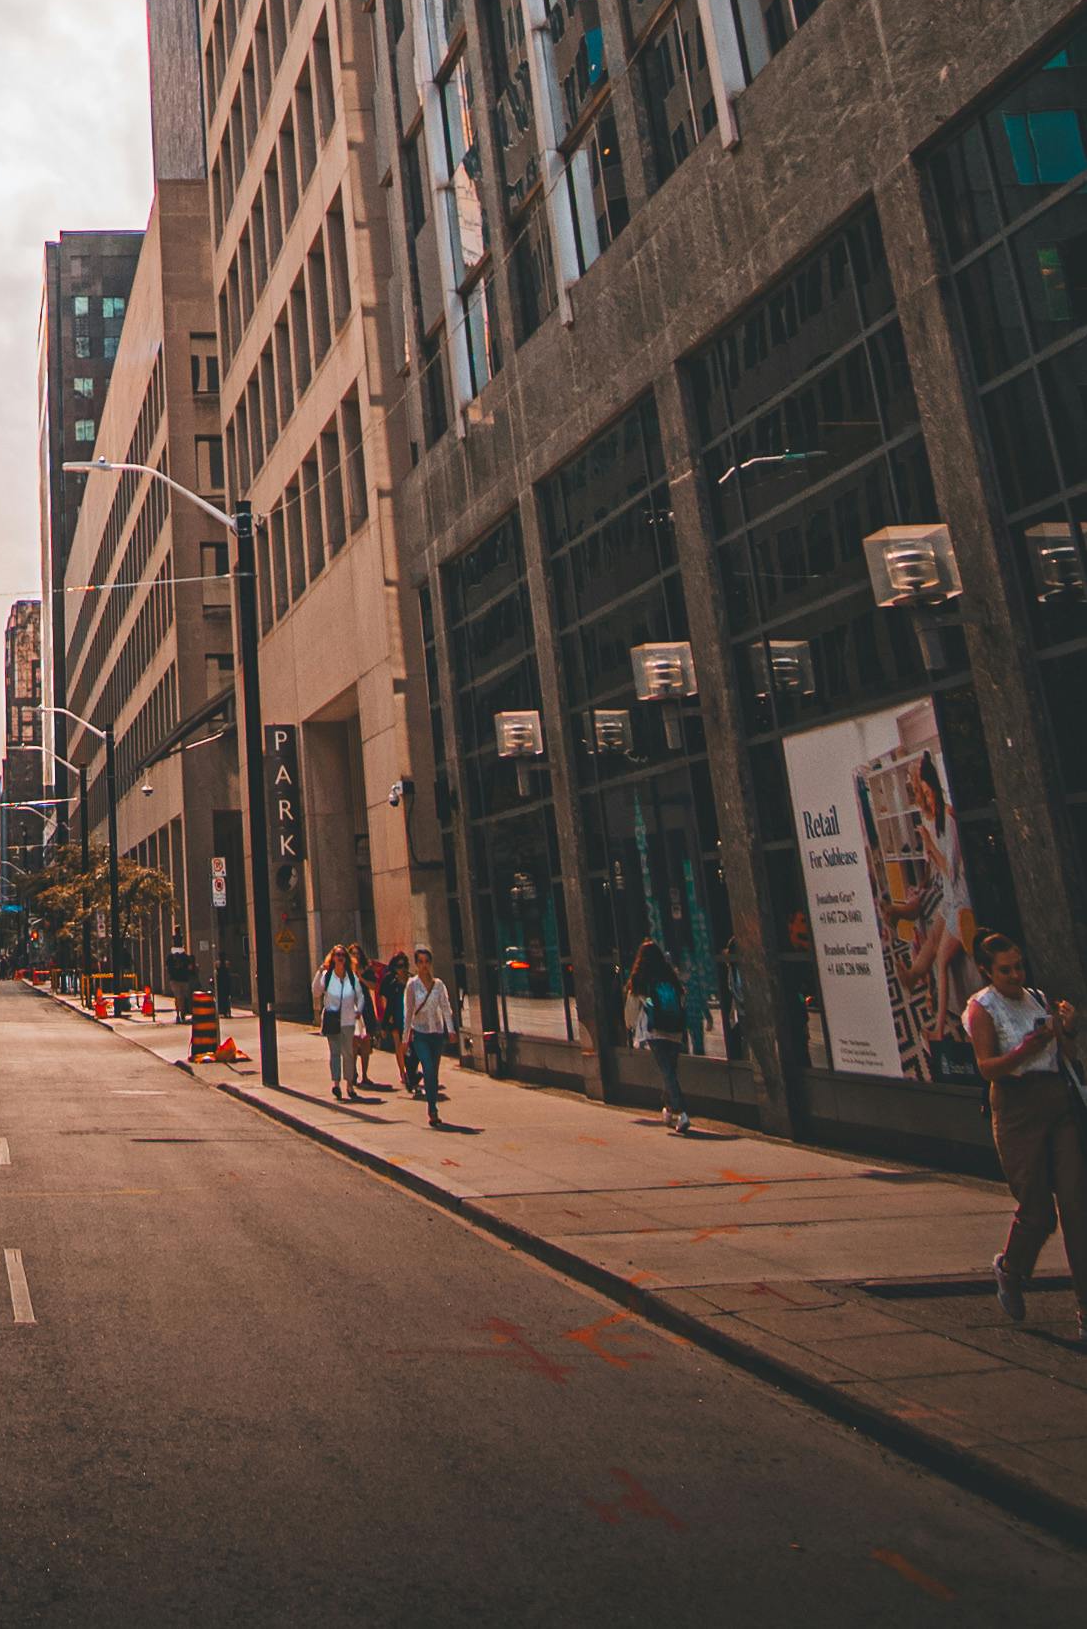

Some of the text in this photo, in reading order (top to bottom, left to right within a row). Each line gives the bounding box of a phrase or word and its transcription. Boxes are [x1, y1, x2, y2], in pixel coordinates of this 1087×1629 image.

[273, 730, 296, 857] PARK
[802, 805, 840, 839] Retail
[809, 846, 858, 869] For Sublease
